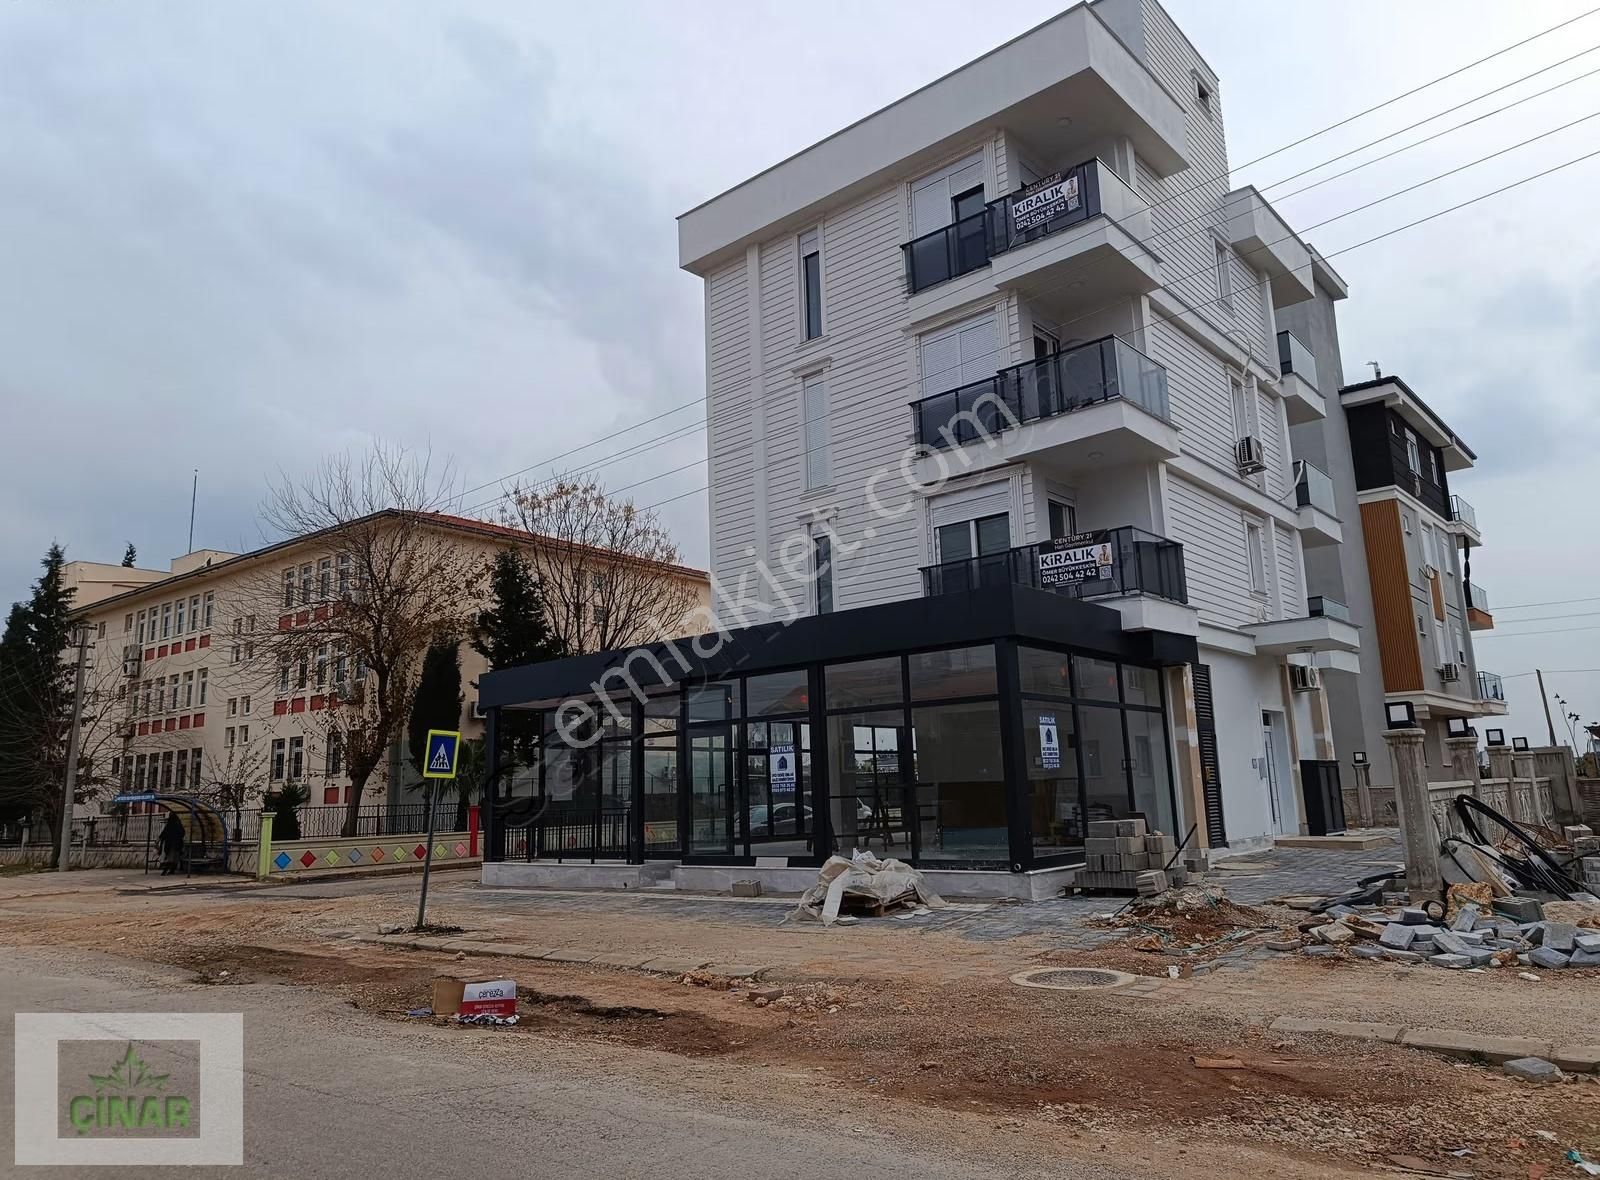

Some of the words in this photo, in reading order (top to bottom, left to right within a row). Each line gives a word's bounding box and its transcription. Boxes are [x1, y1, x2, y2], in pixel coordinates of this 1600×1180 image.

[1016, 219, 1031, 230] 0242
[1031, 213, 1045, 223] 504
[1046, 207, 1055, 216] 42
[1056, 203, 1065, 211] 42
[1054, 534, 1085, 545] CENTURY
[1042, 574, 1059, 584] 0242
[1059, 572, 1074, 580] 504
[1075, 570, 1085, 578] 42
[1086, 568, 1097, 576] 42
[770, 745, 794, 754] SATILIK
